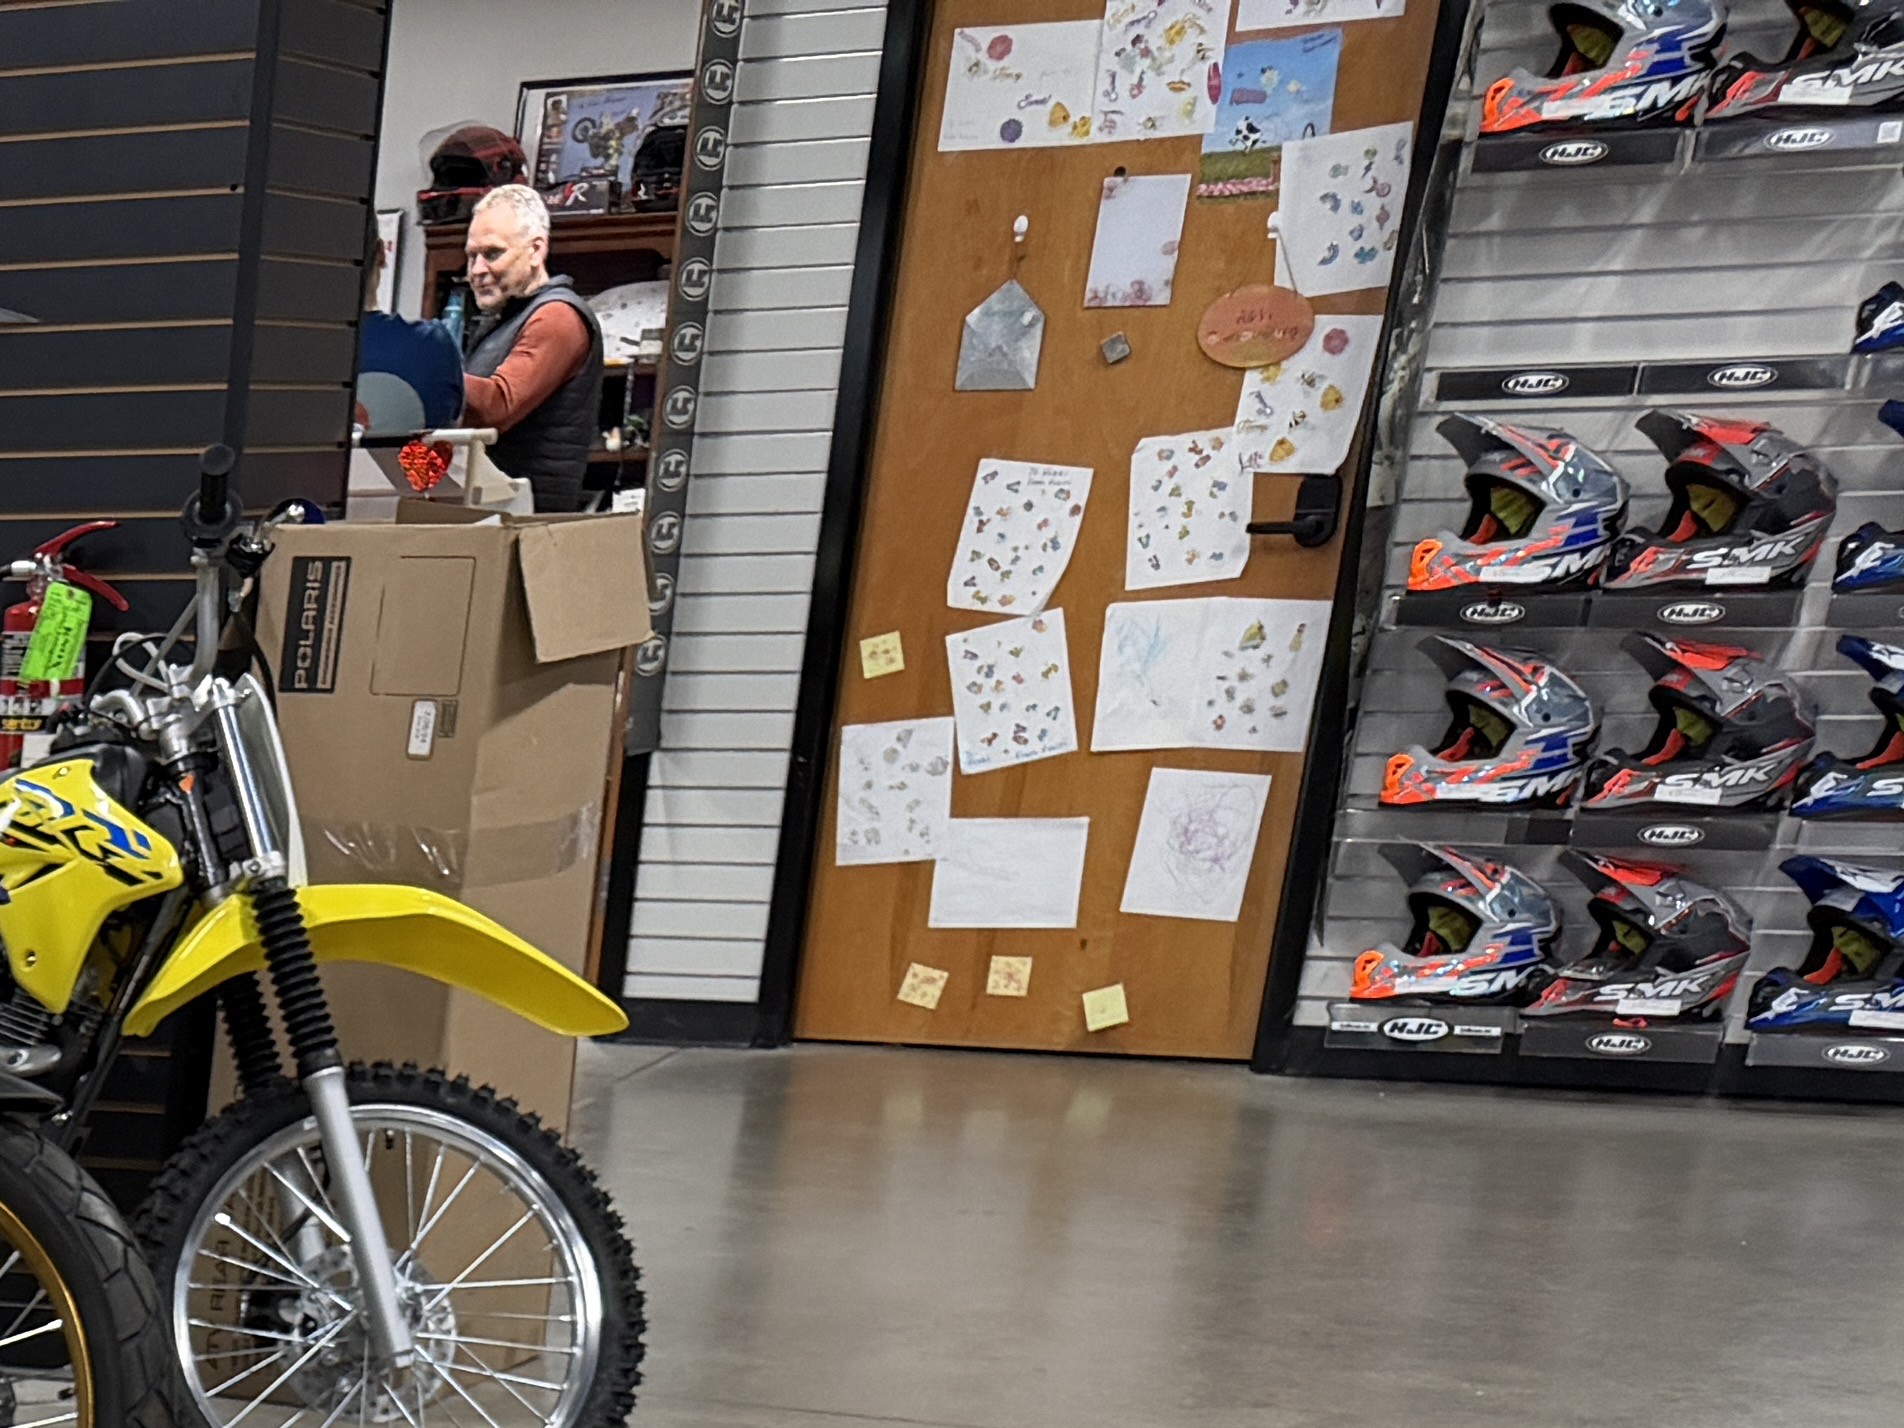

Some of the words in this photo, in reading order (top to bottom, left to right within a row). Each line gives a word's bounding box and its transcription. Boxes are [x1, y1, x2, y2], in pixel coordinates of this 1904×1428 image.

[1768, 129, 1829, 148] HJC
[1549, 144, 1600, 162] HJC
[1511, 374, 1561, 392] HJC
[1717, 366, 1770, 384] HJC
[1687, 537, 1801, 570] SMK
[1667, 605, 1717, 622] HJC
[294, 560, 323, 689] POLARIS
[1665, 764, 1776, 790] SMK
[1648, 826, 1697, 842] HJC
[1597, 976, 1706, 1001] SMK
[1386, 1020, 1442, 1038] HJC
[1596, 1036, 1641, 1052] HJC
[1832, 1046, 1879, 1062] HJC
